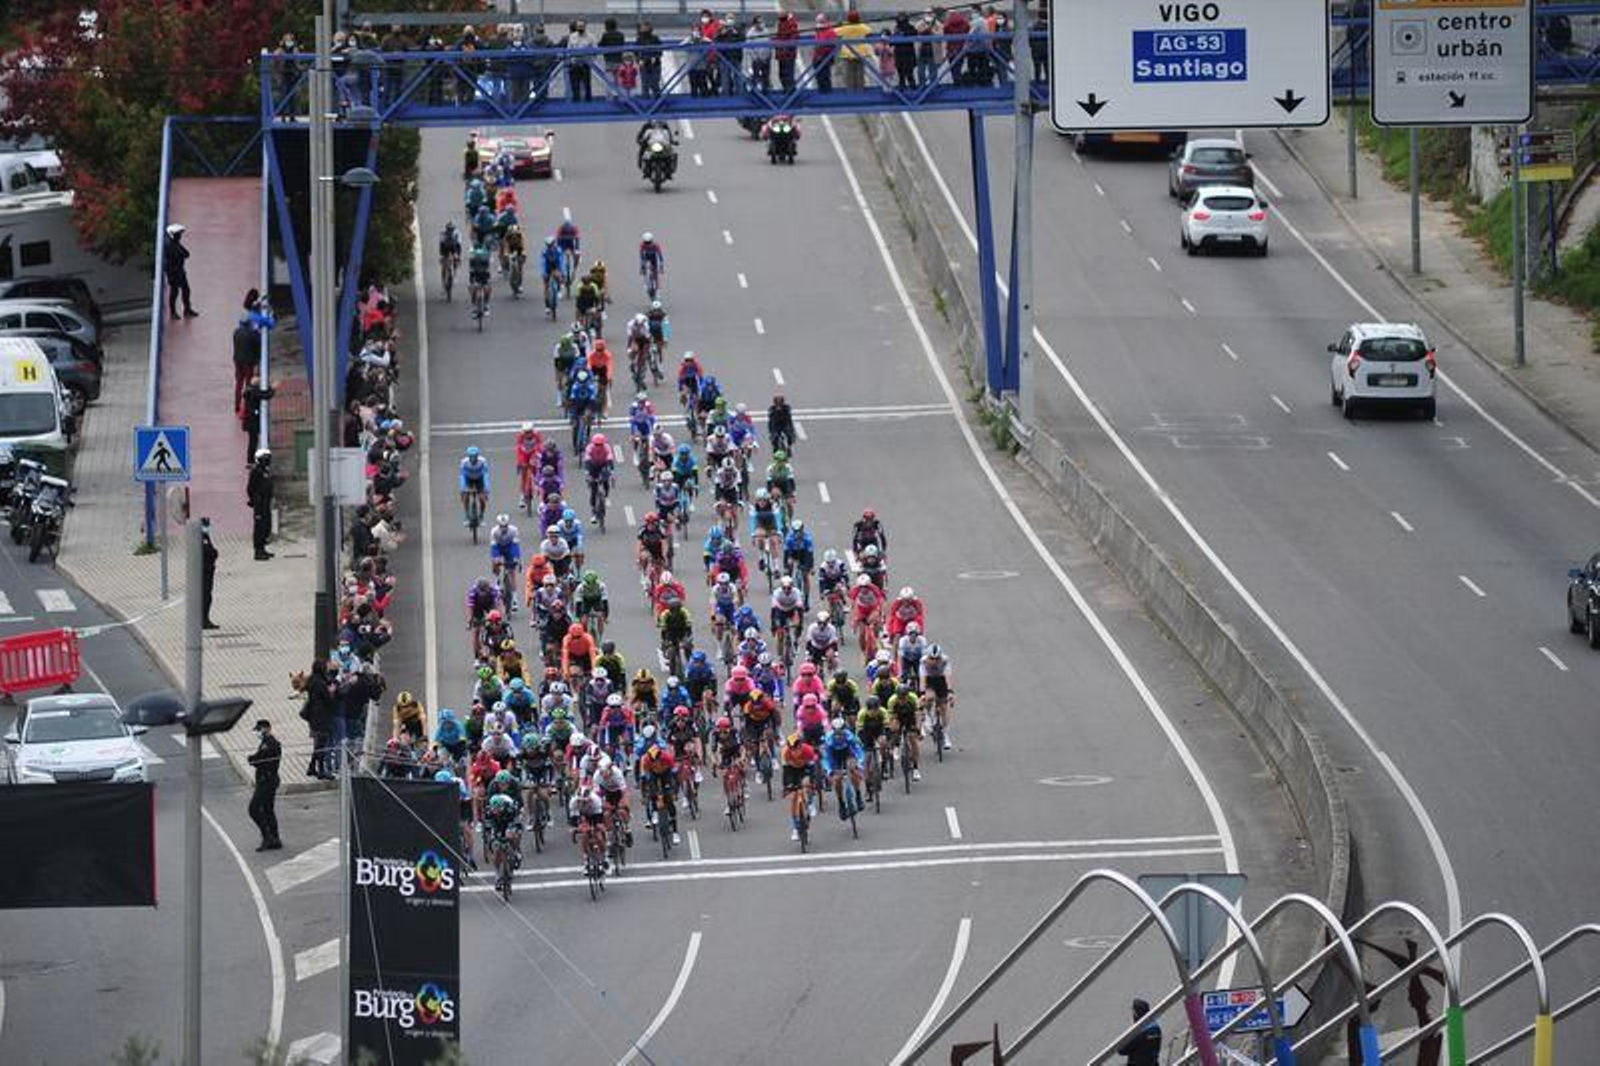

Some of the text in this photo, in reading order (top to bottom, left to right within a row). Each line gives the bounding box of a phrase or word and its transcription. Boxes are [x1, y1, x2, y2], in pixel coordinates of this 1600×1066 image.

[1159, 3, 1219, 22] VIGO
[1437, 12, 1512, 30] centro
[1159, 36, 1221, 51] AG-53
[1437, 39, 1503, 57] urbán
[1136, 59, 1244, 79] Santiago
[1418, 71, 1465, 82] estación
[23, 366, 36, 380] H
